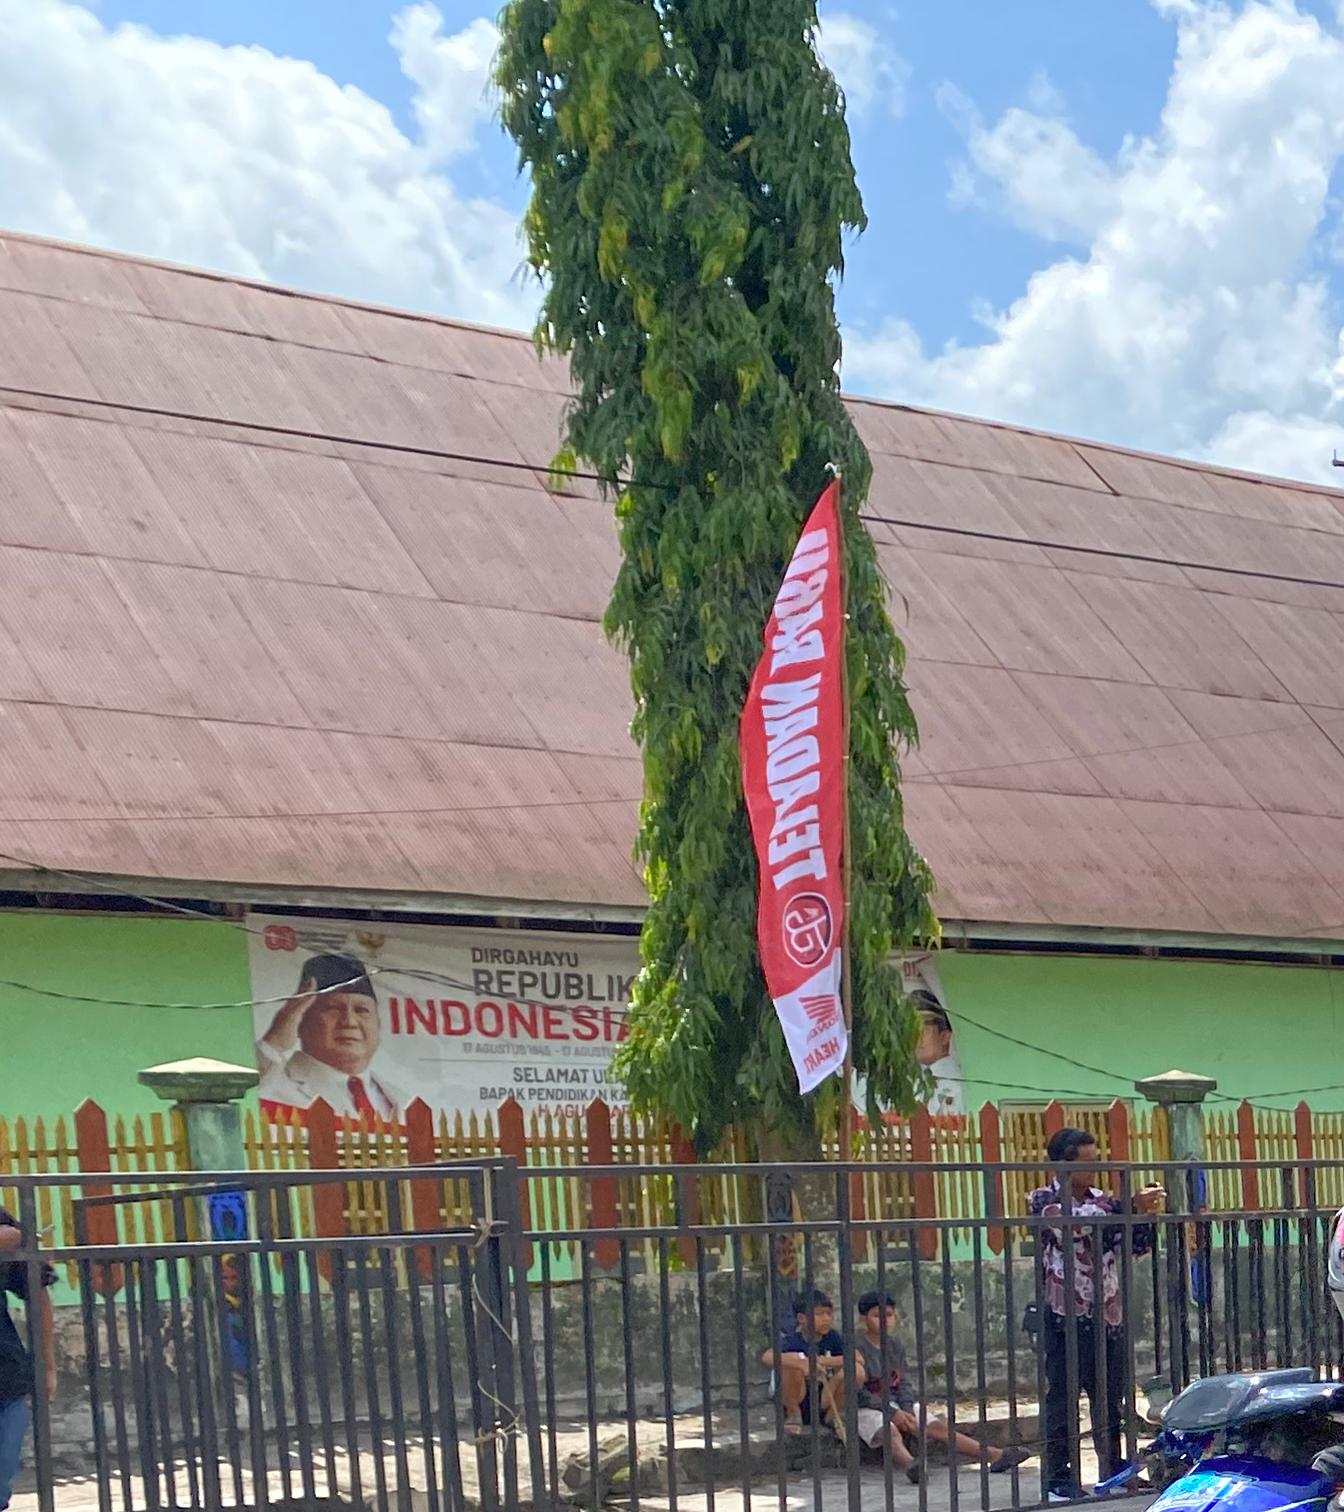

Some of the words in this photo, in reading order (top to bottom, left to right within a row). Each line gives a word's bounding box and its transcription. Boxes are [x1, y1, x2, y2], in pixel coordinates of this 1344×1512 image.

[470, 946, 579, 968] DIRGAHAYU
[472, 968, 636, 1002] REPUBLIK
[513, 1066, 592, 1084] SELAMAT
[479, 1086, 524, 1101] BAPAK
[528, 1087, 608, 1103] PENDIDIKAN
